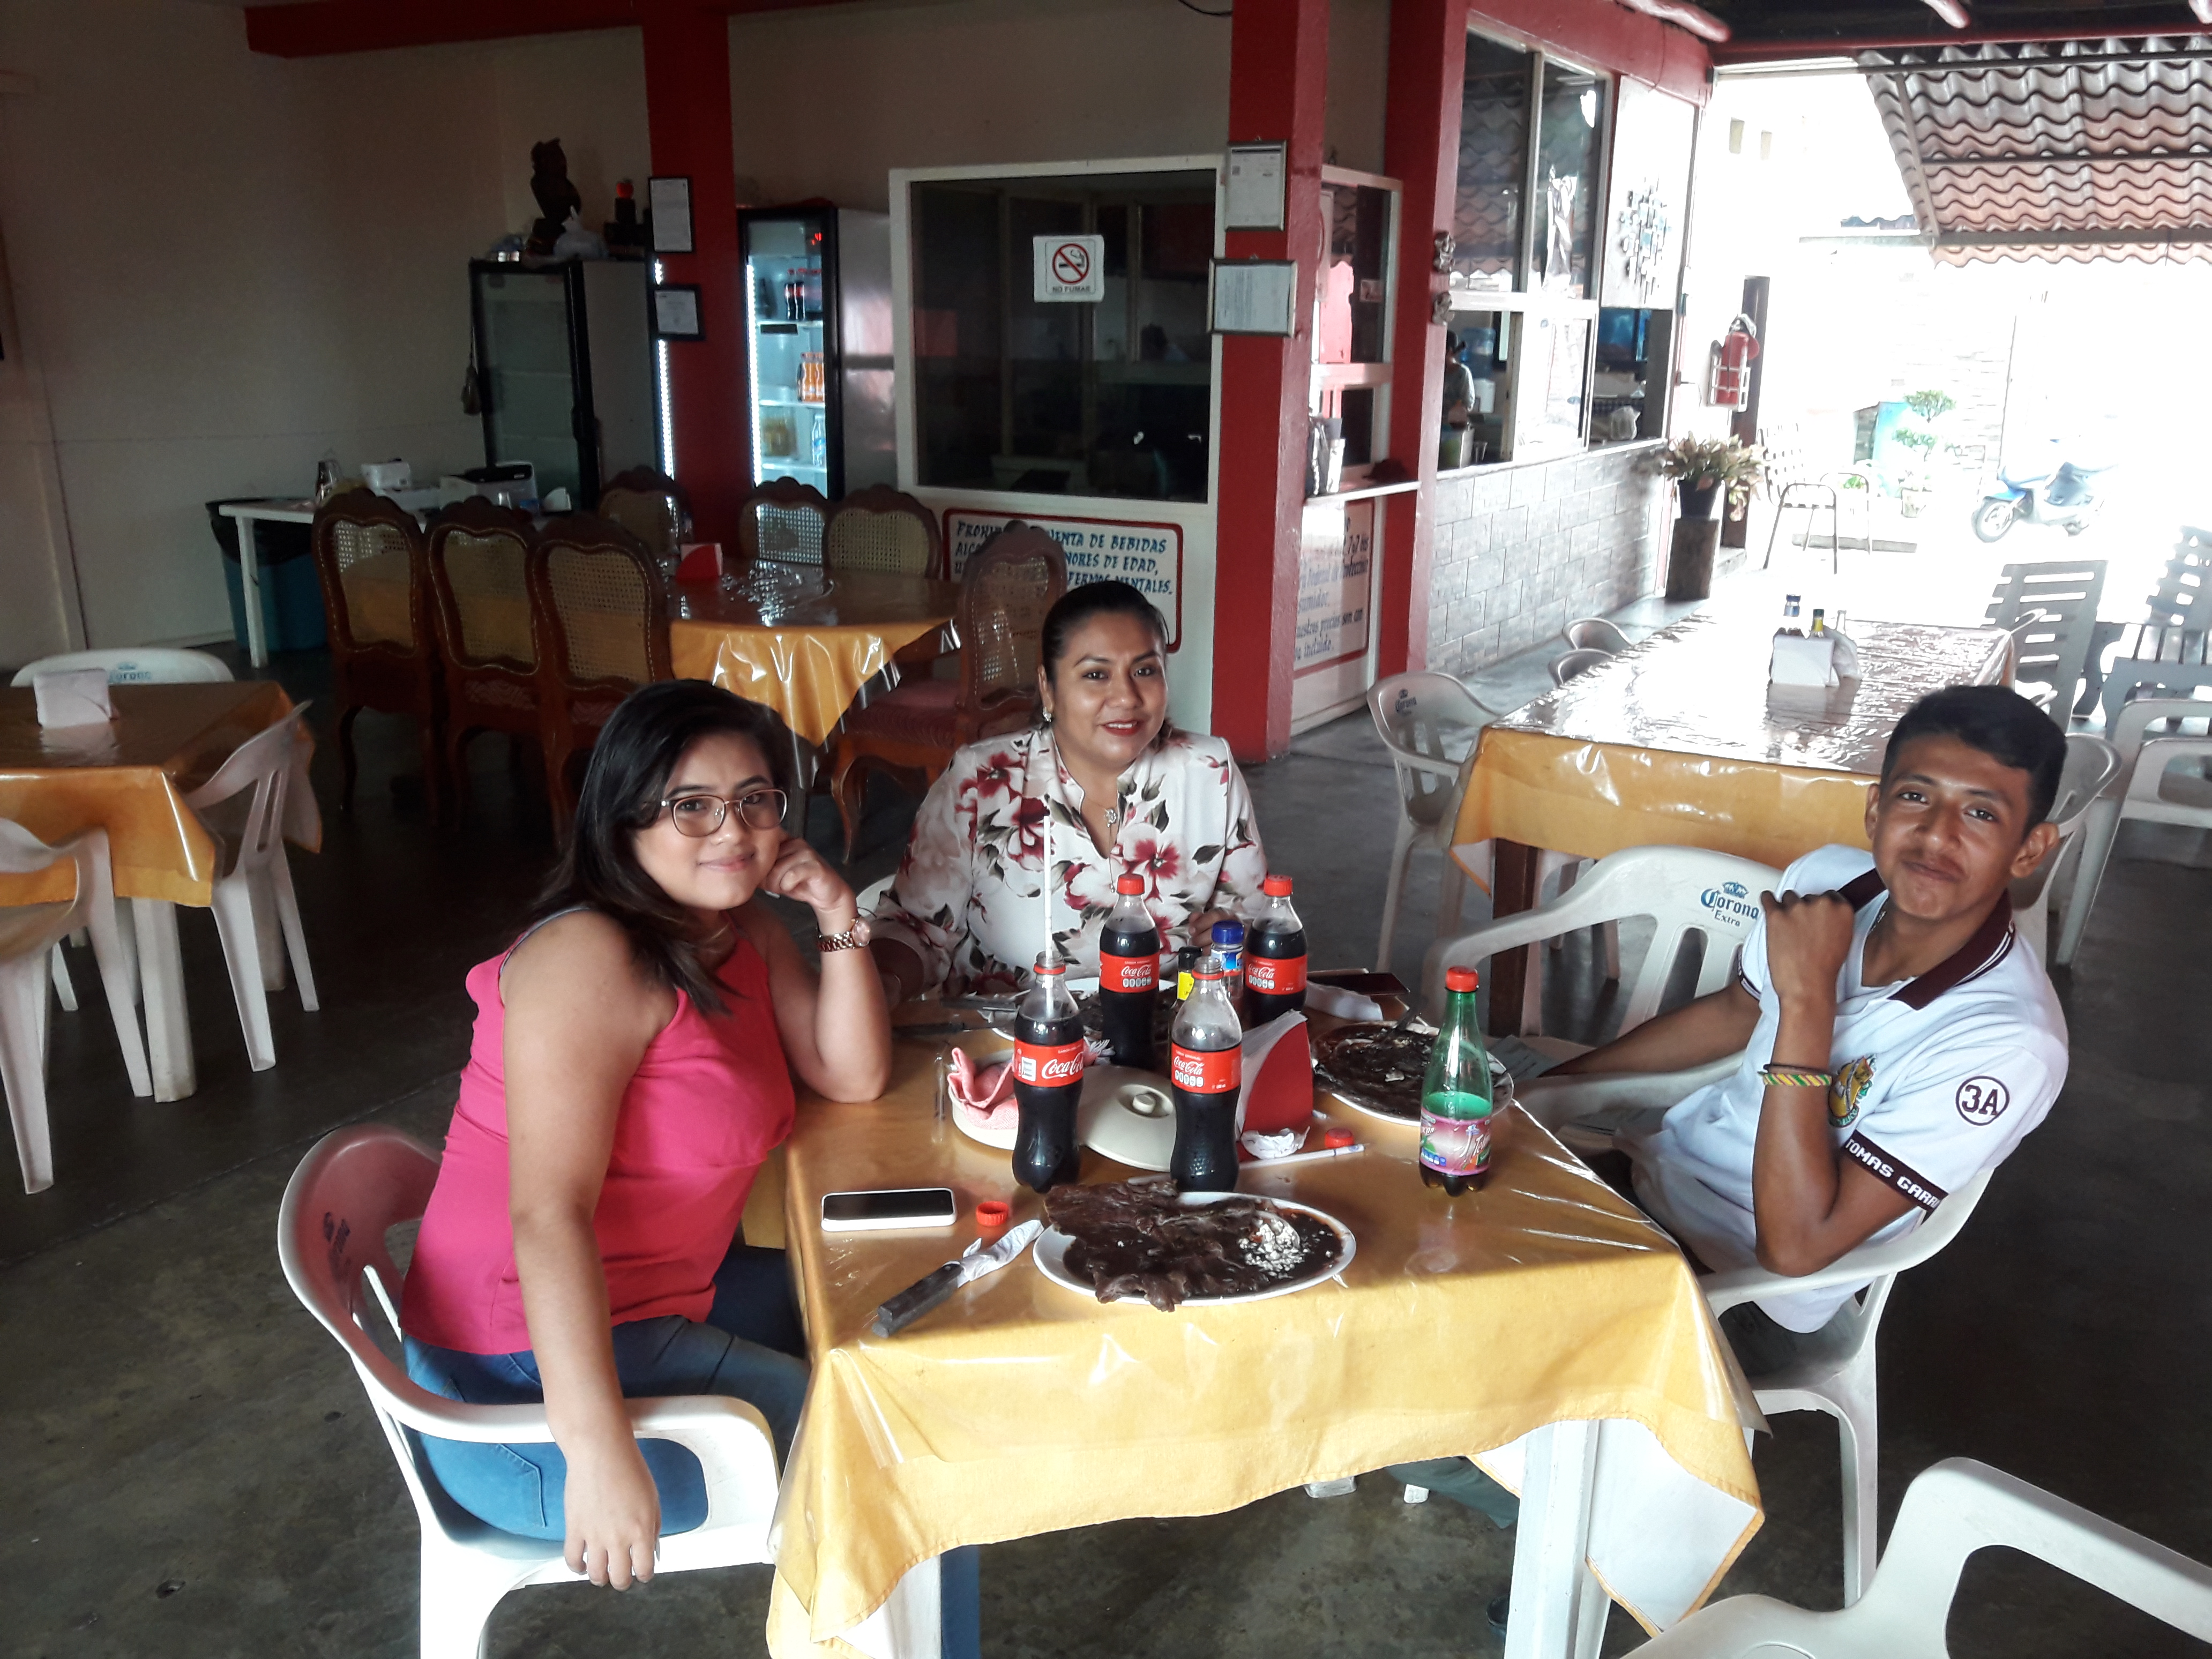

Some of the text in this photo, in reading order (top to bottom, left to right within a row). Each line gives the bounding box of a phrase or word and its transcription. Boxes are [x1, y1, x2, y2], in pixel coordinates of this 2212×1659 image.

[1090, 533, 1105, 548] DE
[1111, 535, 1167, 553] BEBIDAS
[1104, 554, 1119, 569] DE
[1123, 556, 1158, 576] EDAD,
[1700, 888, 1759, 920] Corona
[1714, 909, 1740, 927] Extra
[1174, 1055, 1205, 1075] Coca-Cola
[1962, 1084, 1999, 1116] 3A
[1845, 1139, 1894, 1178] TOMAS
